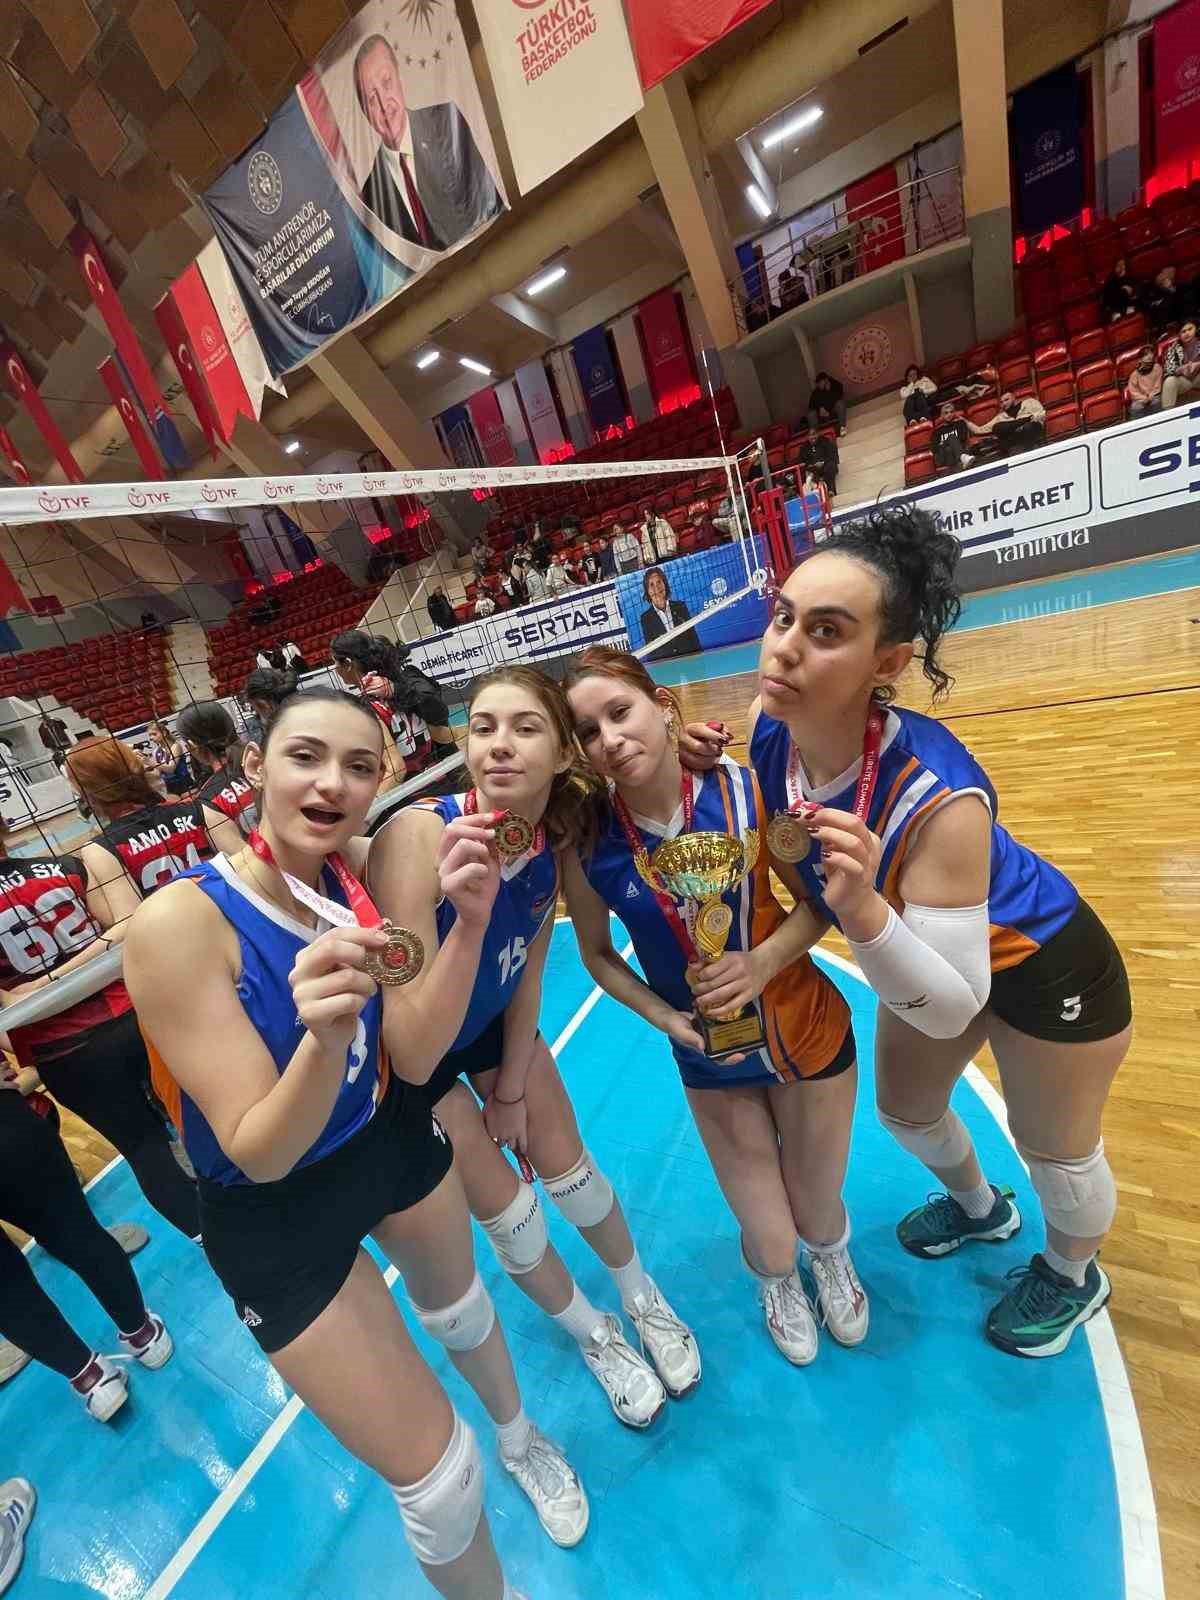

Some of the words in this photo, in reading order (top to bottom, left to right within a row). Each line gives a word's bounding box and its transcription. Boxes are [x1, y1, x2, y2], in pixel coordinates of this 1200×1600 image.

[515, 0, 590, 54] TÜRKİ
[521, 4, 594, 72] BASKETBOL
[525, 18, 597, 86] FEDERASYONU
[272, 200, 318, 250] ANTRENÖR
[261, 208, 332, 279] SPORCULARIMIZA
[295, 226, 336, 270] DİLİYORUM
[1138, 432, 1200, 480] S
[146, 491, 171, 503] TVF
[217, 487, 239, 499] TVF
[276, 484, 296, 496] TVF
[328, 481, 345, 493] TVF
[372, 478, 387, 490] TVF
[411, 477, 425, 488] TVF
[61, 496, 91, 509] TVF
[935, 510, 974, 533] MİR
[978, 480, 1075, 524] TİCARET
[420, 653, 448, 671] DEMİR
[446, 645, 484, 664] TİCARET
[172, 814, 198, 834] SK
[30, 862, 67, 880] SK
[0, 886, 98, 975] 62
[498, 935, 529, 987] 15
